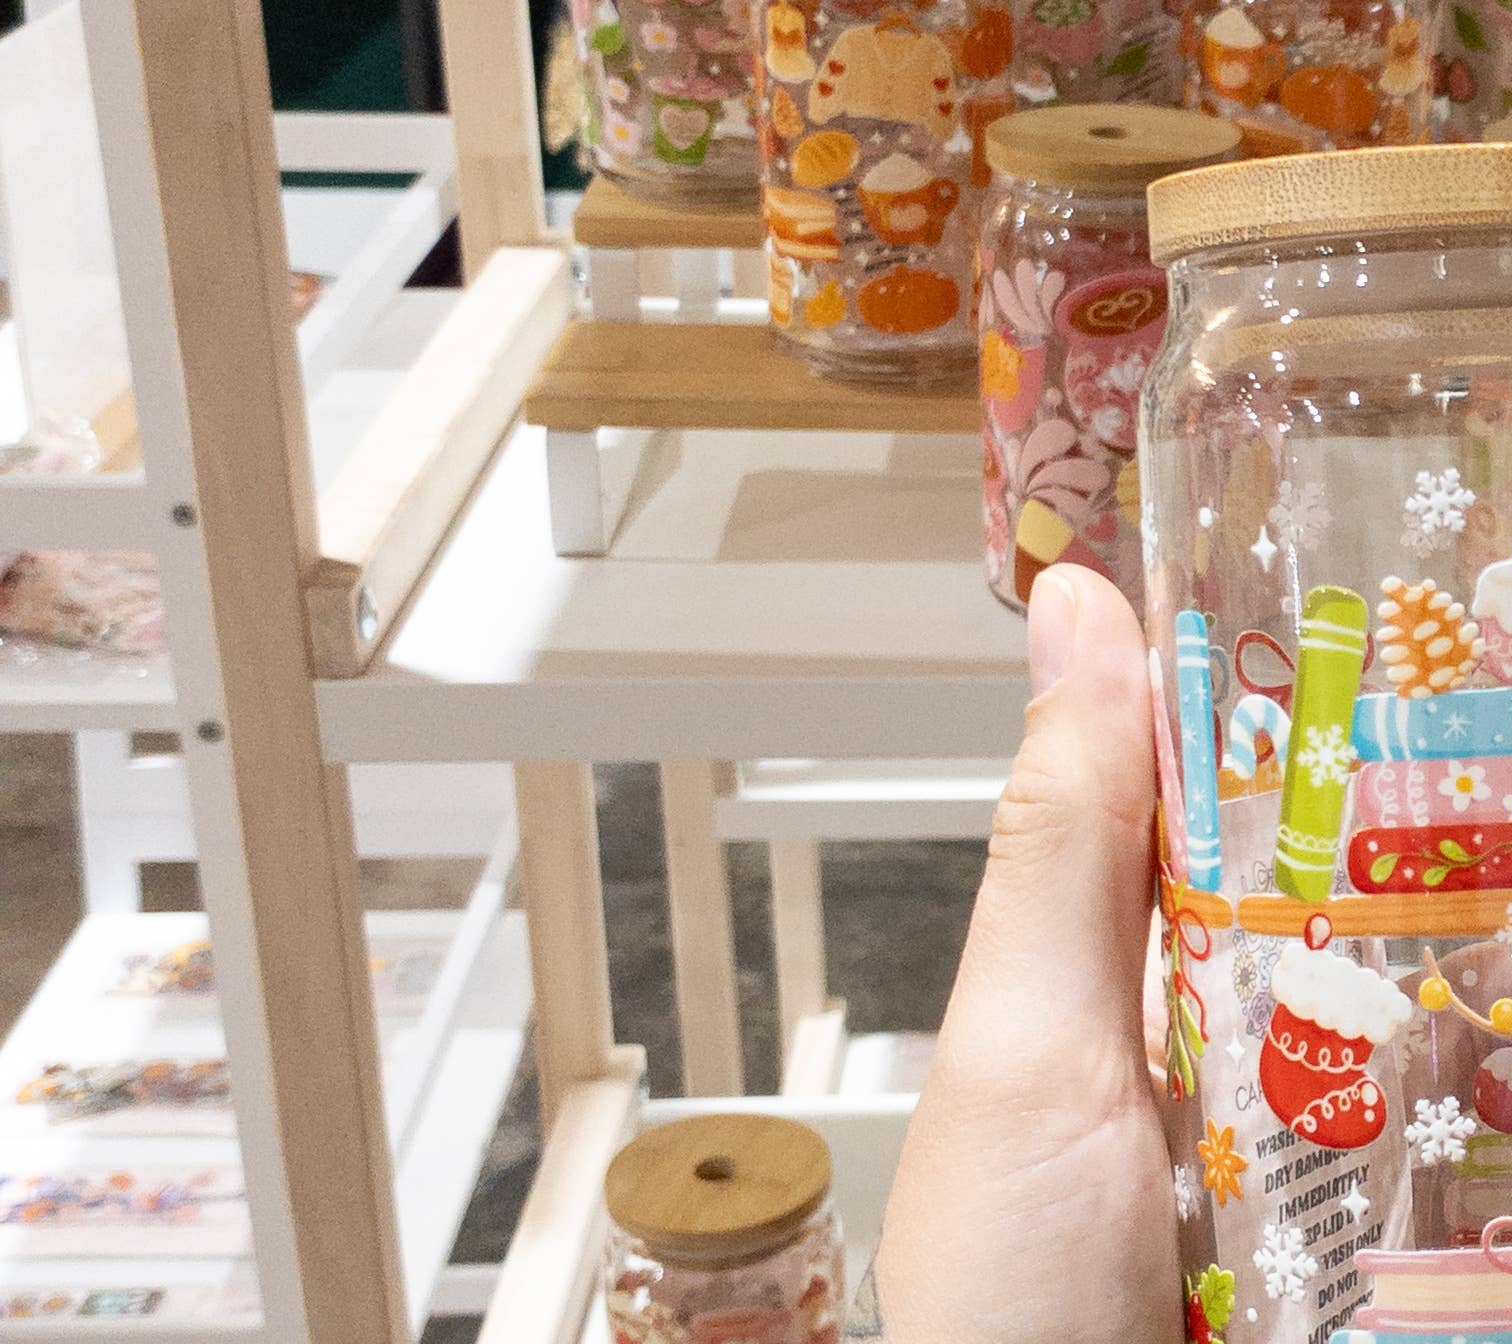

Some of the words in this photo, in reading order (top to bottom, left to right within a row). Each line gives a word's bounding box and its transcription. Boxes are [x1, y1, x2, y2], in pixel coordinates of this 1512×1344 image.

[1264, 1160, 1294, 1194] DRY
[1323, 1211, 1344, 1238] LID
[1355, 1220, 1384, 1251] ONLY
[1318, 1283, 1335, 1309] DO
[1337, 1269, 1358, 1297] NOT
